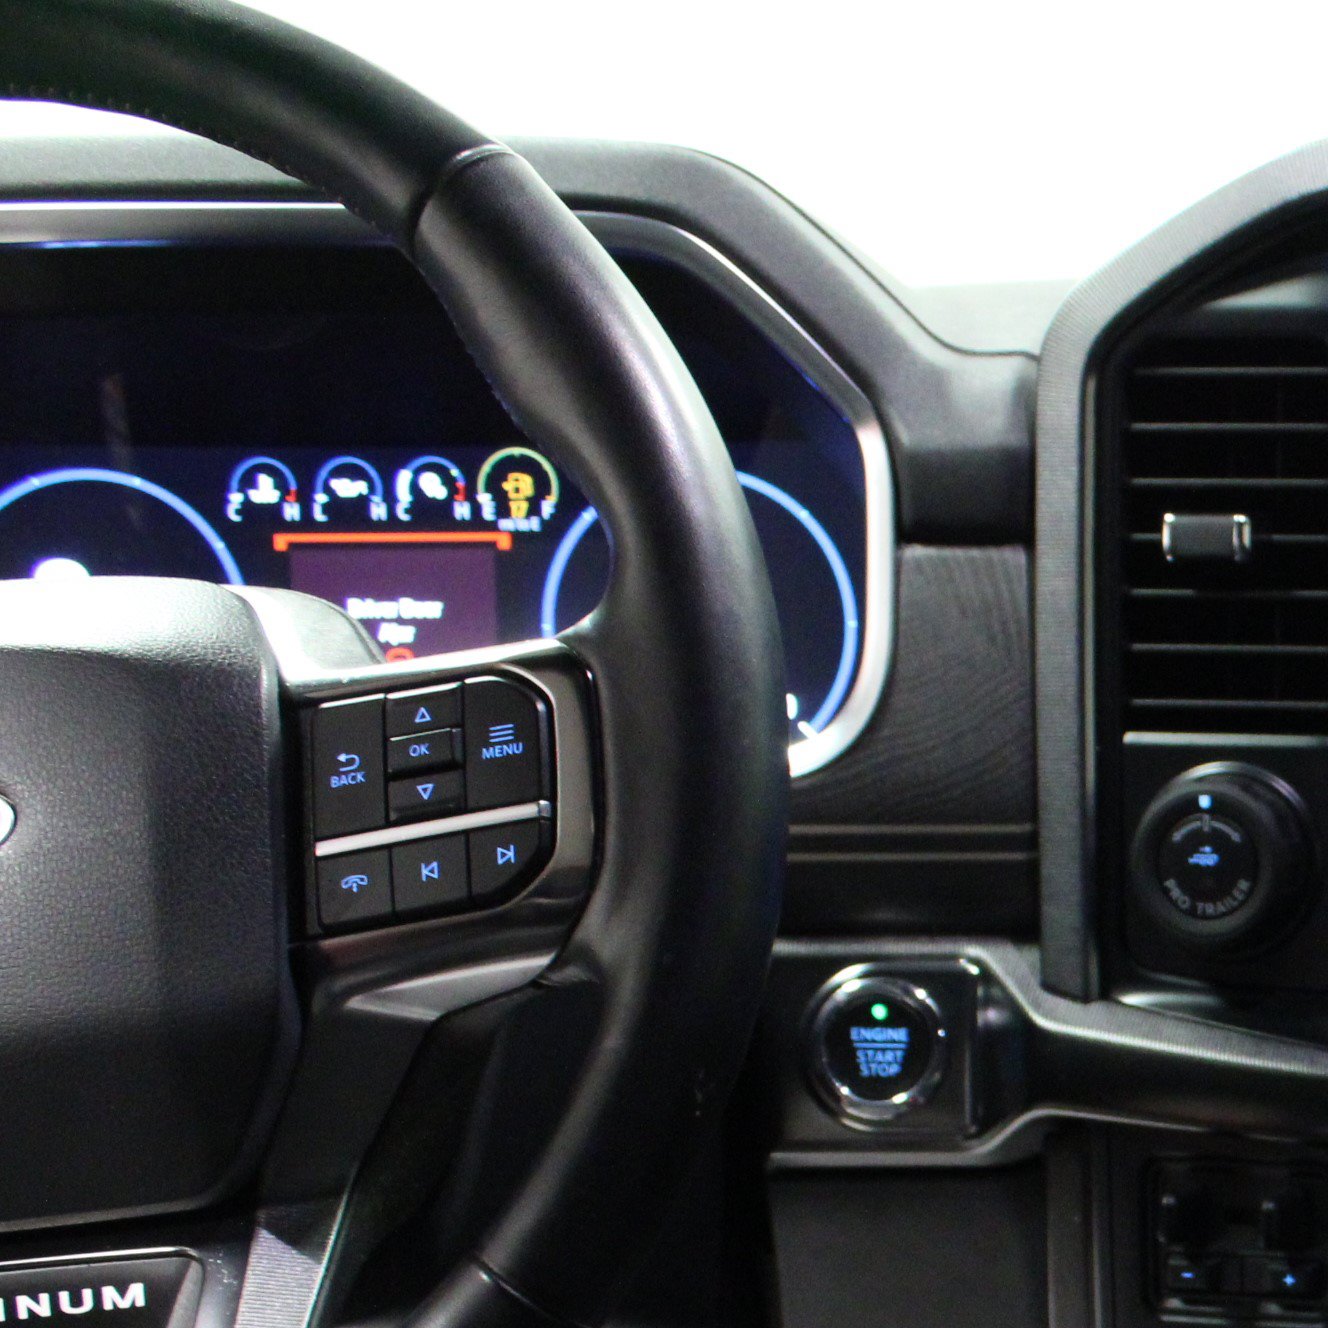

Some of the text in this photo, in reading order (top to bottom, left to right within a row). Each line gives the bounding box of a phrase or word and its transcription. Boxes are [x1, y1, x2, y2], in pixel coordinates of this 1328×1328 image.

[227, 501, 242, 522] C
[408, 743, 430, 757] OK
[481, 742, 523, 760] MENU
[330, 771, 366, 788] BACK
[850, 1026, 910, 1043] ENGINE
[856, 1050, 905, 1063] START
[859, 1063, 902, 1078] STOP
